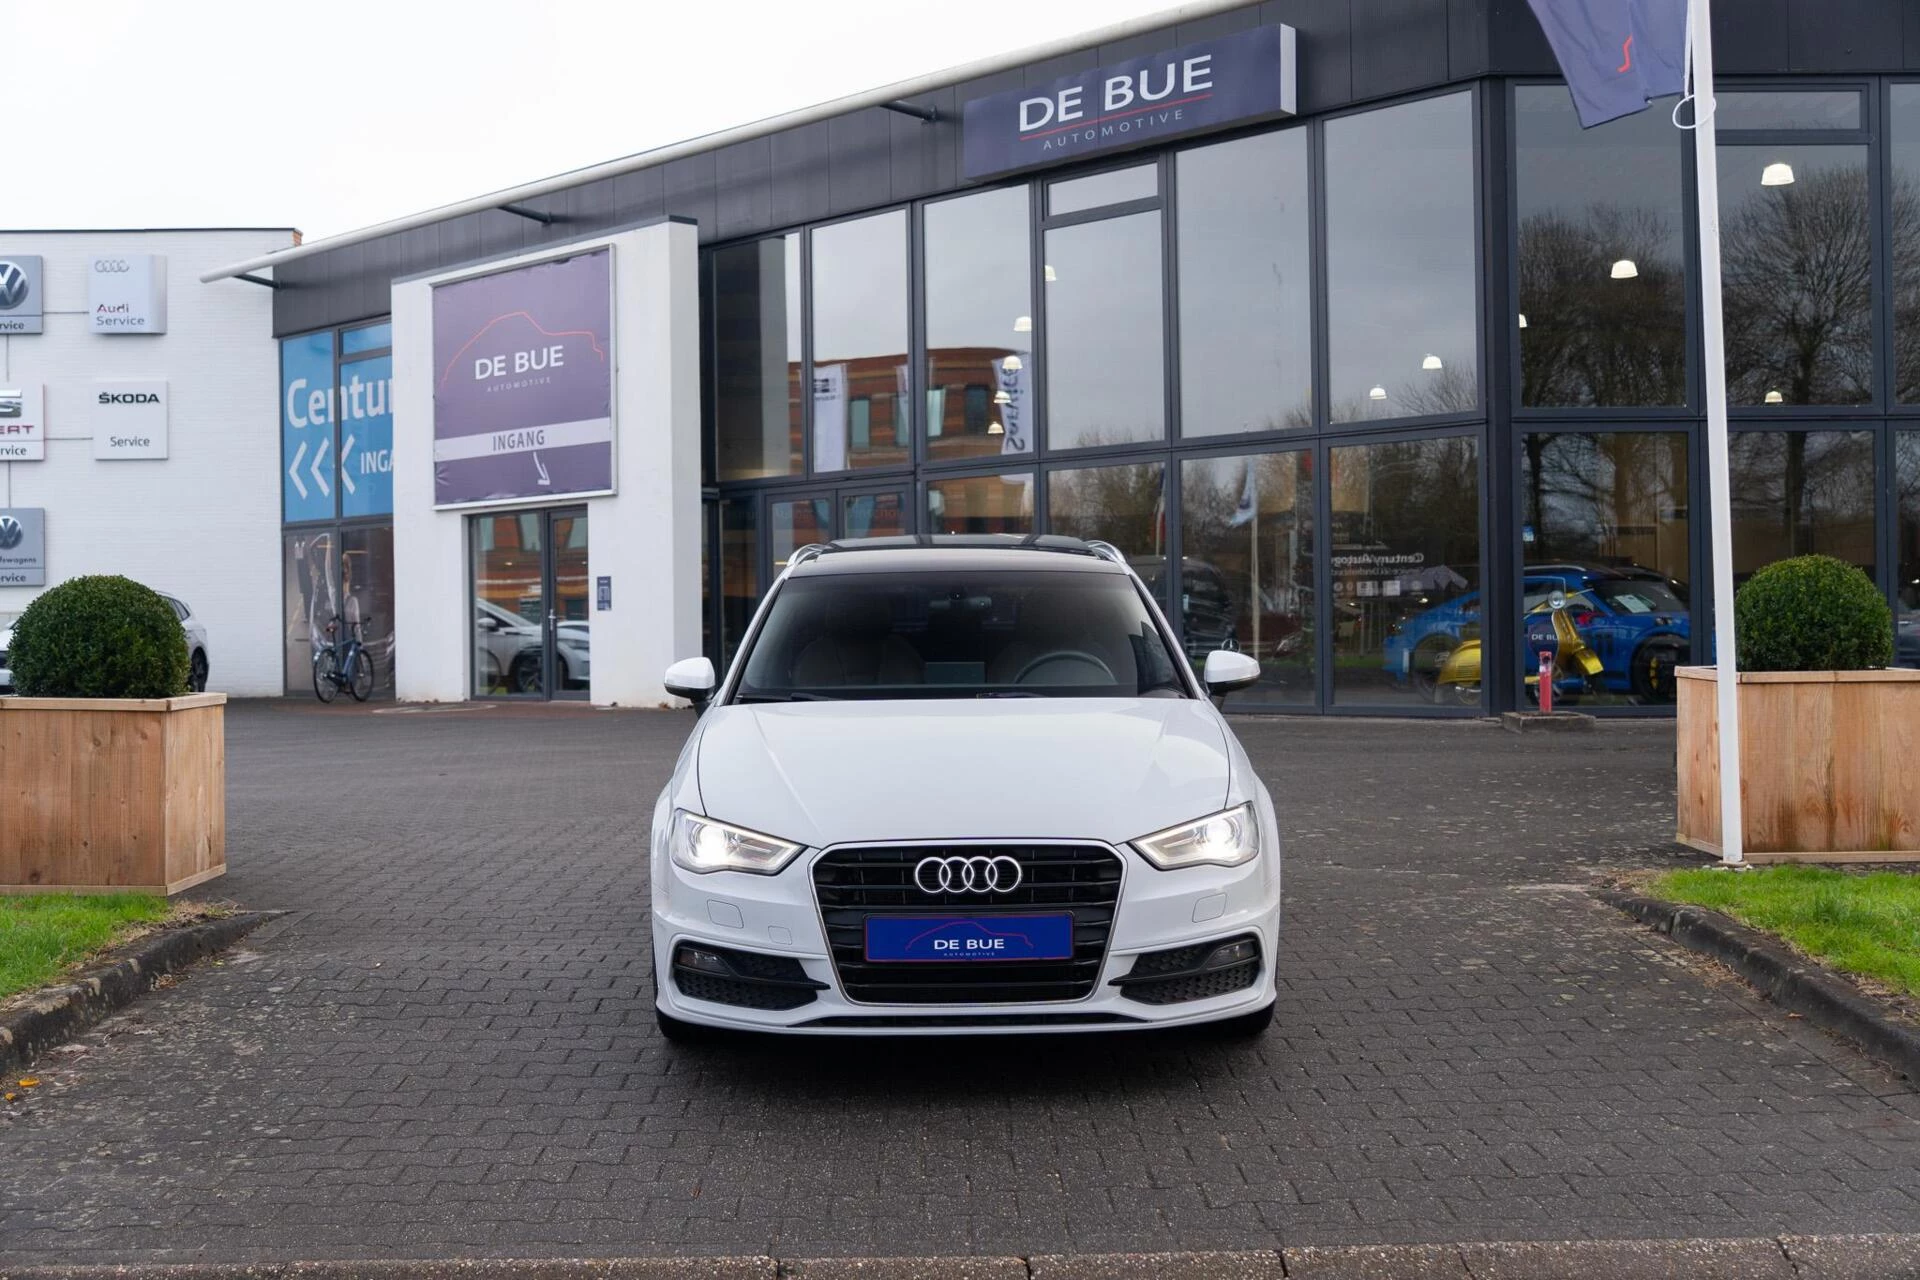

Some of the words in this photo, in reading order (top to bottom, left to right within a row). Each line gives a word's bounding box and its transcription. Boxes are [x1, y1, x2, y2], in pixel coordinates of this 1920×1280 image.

[1019, 86, 1083, 132] DE
[1105, 54, 1213, 111] BUE
[1043, 109, 1183, 151] AUTOMOTIVE
[97, 303, 129, 313] Audi
[0, 320, 24, 330] rvice
[96, 315, 145, 326] Service
[475, 355, 507, 380] DE
[515, 345, 564, 373] BUE
[487, 376, 551, 392] AUTOMOTIVE
[99, 392, 160, 404] ŠKODA
[110, 436, 150, 447] Service
[493, 430, 545, 452] INGANG
[0, 445, 27, 456] rvice
[1, 573, 26, 582] rvice
[1531, 633, 1543, 641] DE
[934, 939, 960, 950] DE
[966, 939, 1004, 949] BUE
